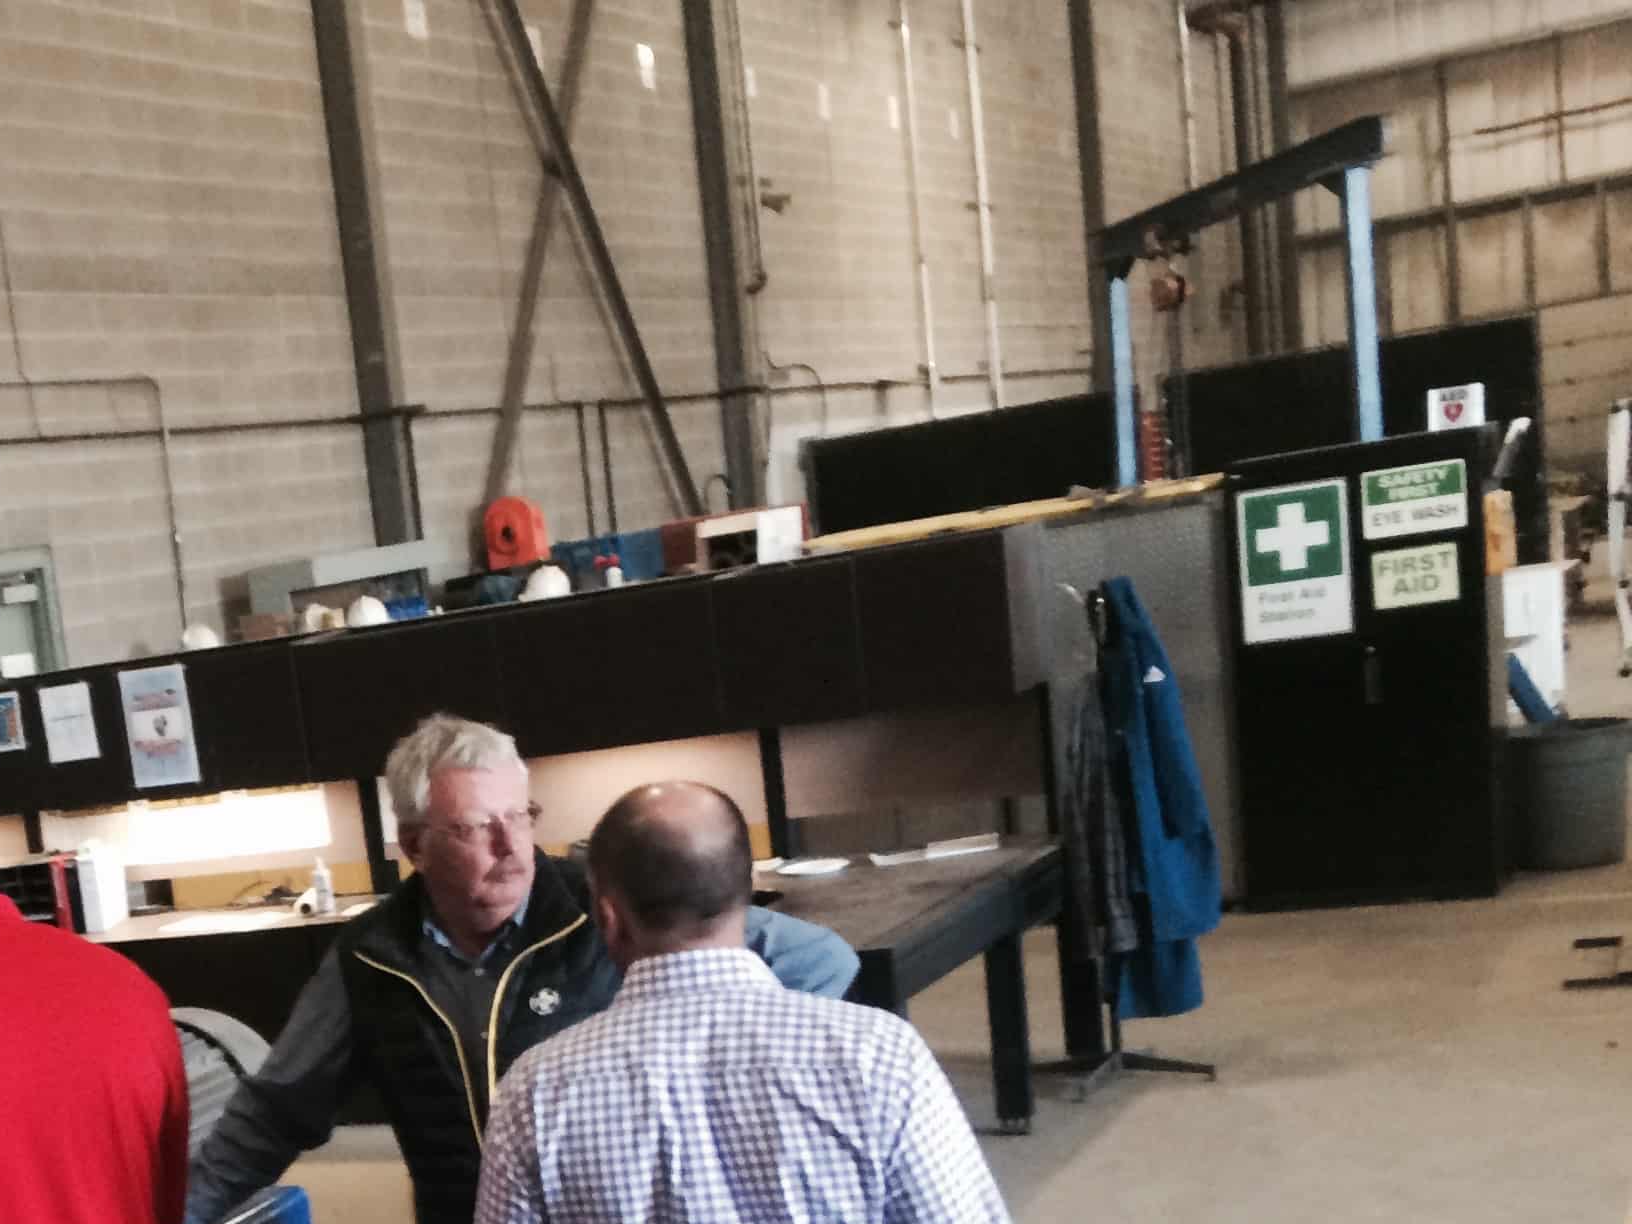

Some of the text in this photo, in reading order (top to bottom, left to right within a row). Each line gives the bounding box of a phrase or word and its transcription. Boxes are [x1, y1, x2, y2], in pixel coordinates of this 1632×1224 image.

[1376, 466, 1450, 489] SAFETY
[1378, 551, 1452, 597] FIRST AID
